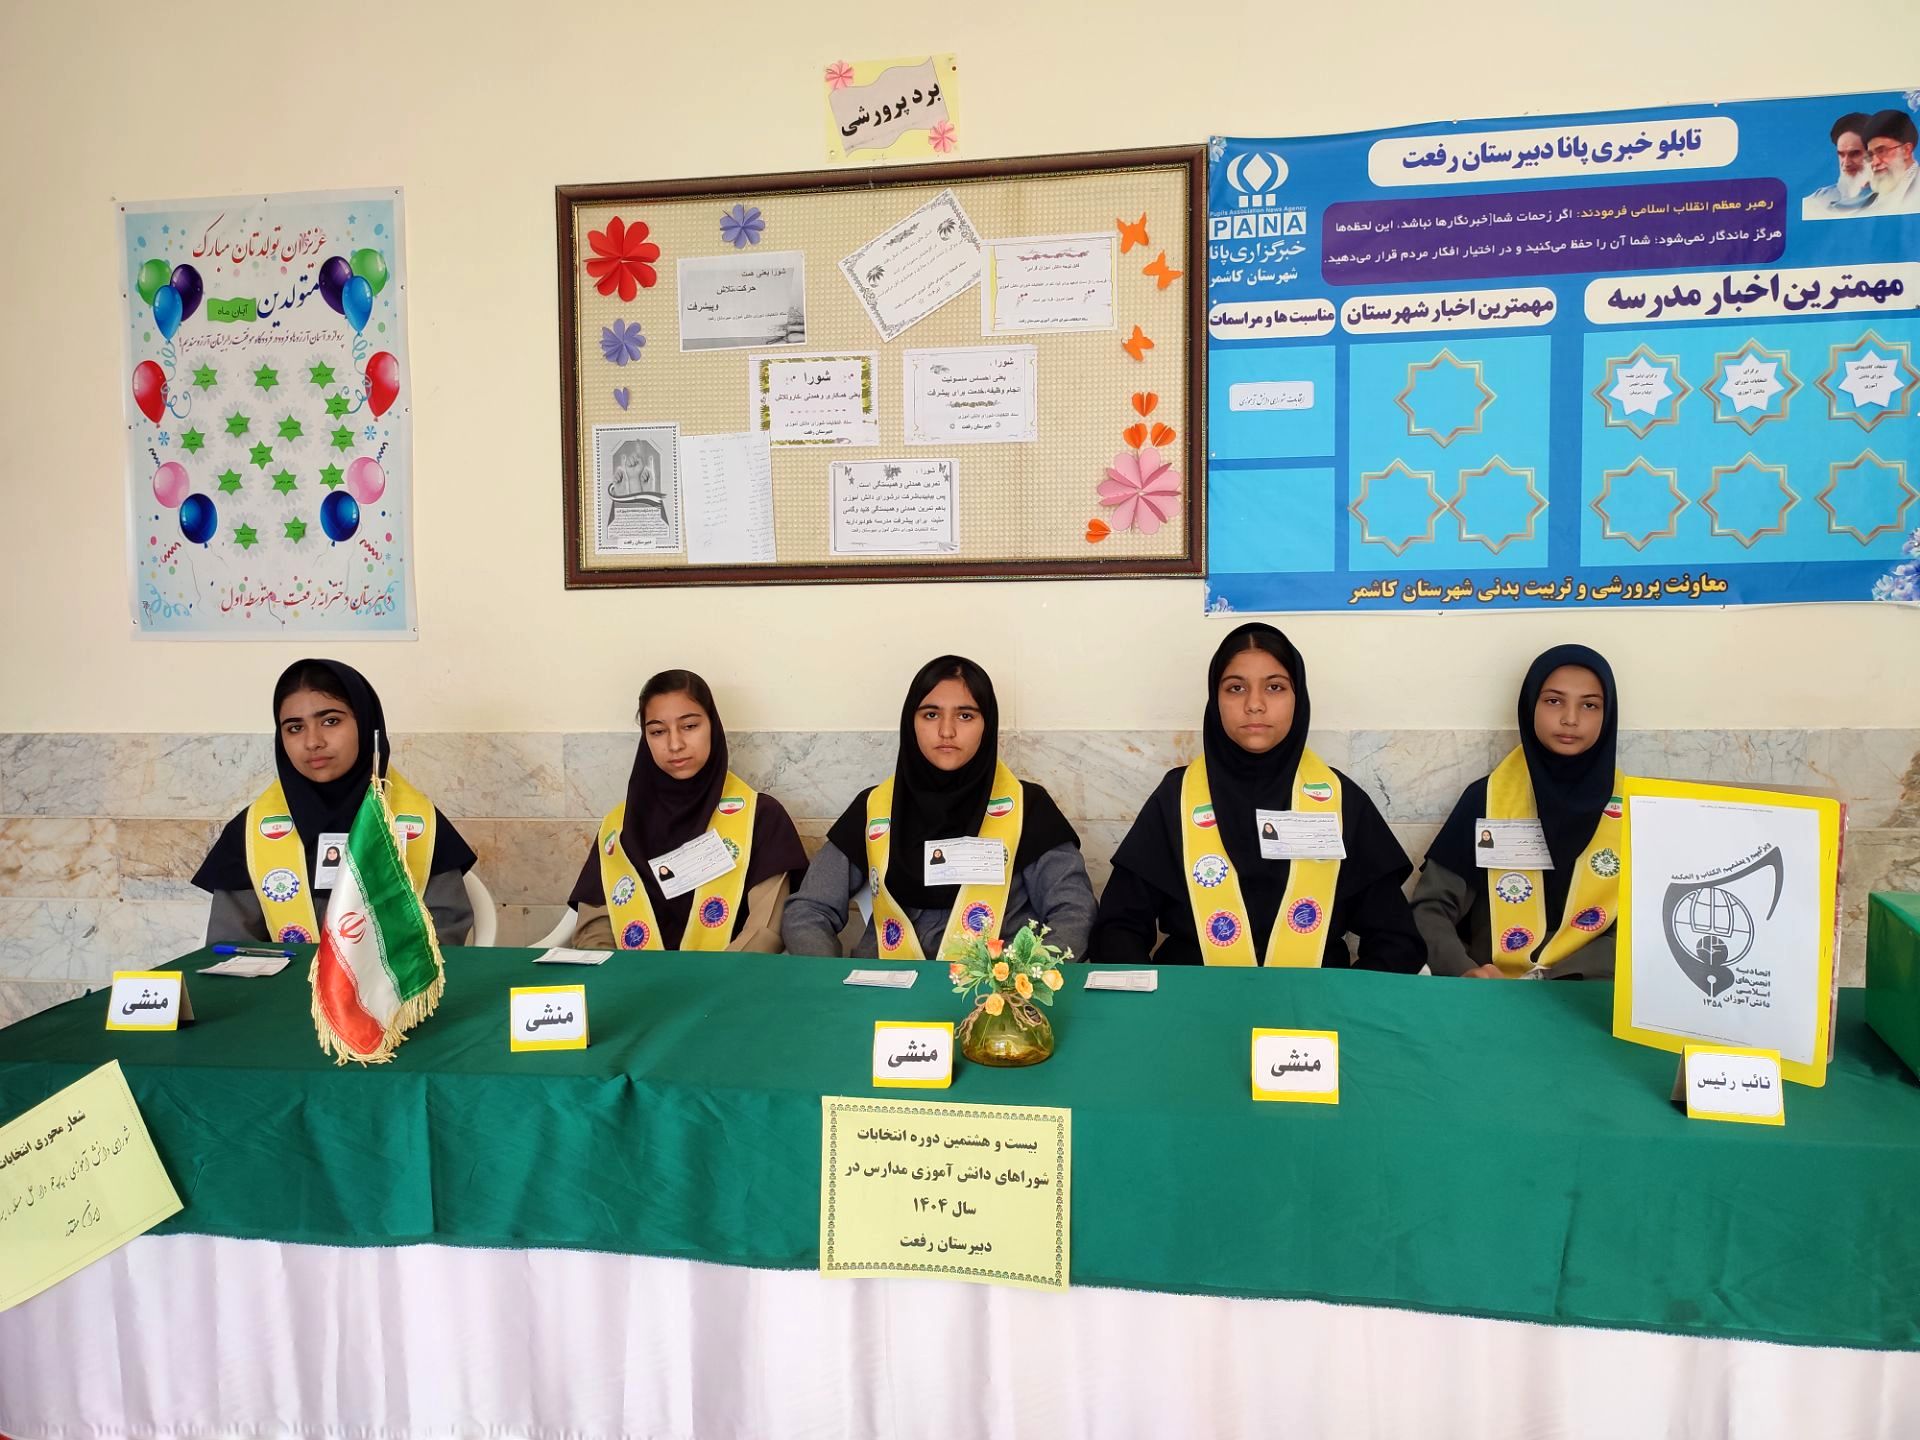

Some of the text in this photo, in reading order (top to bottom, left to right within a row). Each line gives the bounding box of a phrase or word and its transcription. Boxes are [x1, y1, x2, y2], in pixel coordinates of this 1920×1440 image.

[841, 82, 942, 137] برد پرورشی
[1402, 129, 1702, 173] تابلو خبری پانا دبیرستان رفعت
[1556, 209, 1572, 222] اگر
[1576, 206, 1627, 220] فرمودند:
[1630, 204, 1669, 218] اسلامی
[1673, 203, 1709, 215] انقلاب
[1712, 201, 1742, 213] معظم
[1746, 199, 1774, 211] رهبر
[1212, 213, 1304, 238] PANA
[1375, 219, 1394, 233] این
[1516, 210, 1552, 223] زحمات
[192, 213, 327, 272] عزیزان تولدتان مبارک
[1570, 239, 1593, 249] حفظ
[1596, 239, 1606, 250] را
[1610, 235, 1626, 250] آن
[1630, 235, 1650, 246] شما
[1709, 231, 1750, 244] ماندگار
[1753, 228, 1782, 242] هرگز
[1209, 239, 1306, 266] خبرگزاری پانا
[1375, 249, 1397, 263] قرار
[1400, 249, 1428, 262] مردم
[1432, 247, 1459, 260] افکار
[1463, 245, 1495, 258] اختیار
[1499, 243, 1511, 256] در
[1516, 245, 1522, 255] و
[1208, 266, 1298, 287] شهرستان کاشمر
[256, 274, 320, 327] متولدین
[1607, 272, 1905, 318] مهمترین اخبار مدرسه
[217, 304, 249, 318] آبان ماه
[1210, 308, 1335, 329] مناسبت ها و مراسمات
[1347, 298, 1554, 325] مهمترین اخبار شهرستان
[804, 369, 831, 386] شورا
[220, 586, 243, 612] اول
[283, 578, 317, 610] رفعت
[317, 581, 350, 609] دخترانه
[350, 584, 392, 616] دبیرستان
[1347, 574, 1729, 605] معاونت پرورشی و تربیت بدنی شهرستان کاشمر
[1735, 966, 1771, 978] اتحادیه
[122, 989, 169, 1015] منشی
[1735, 986, 1771, 998] اسلامی
[1703, 998, 1723, 1009] ۱۳۵۸
[525, 1003, 574, 1032] منشی
[887, 1040, 938, 1068] منشی
[1270, 1048, 1322, 1077] منشی
[1696, 1071, 1771, 1093] نائب رئیس
[67, 1109, 86, 1132] شعار
[34, 1126, 64, 1151] محوری
[113, 1125, 131, 1155] شورای
[857, 1127, 1038, 1155] بیست و هشتمین دوره انتخابات
[92, 1140, 110, 1167] دانش
[844, 1160, 1050, 1189] شوراهای دانش آموزی مدارس در
[913, 1197, 977, 1218] سال ۱۴۰۴
[899, 1232, 993, 1256] دبیرستان رفعت
